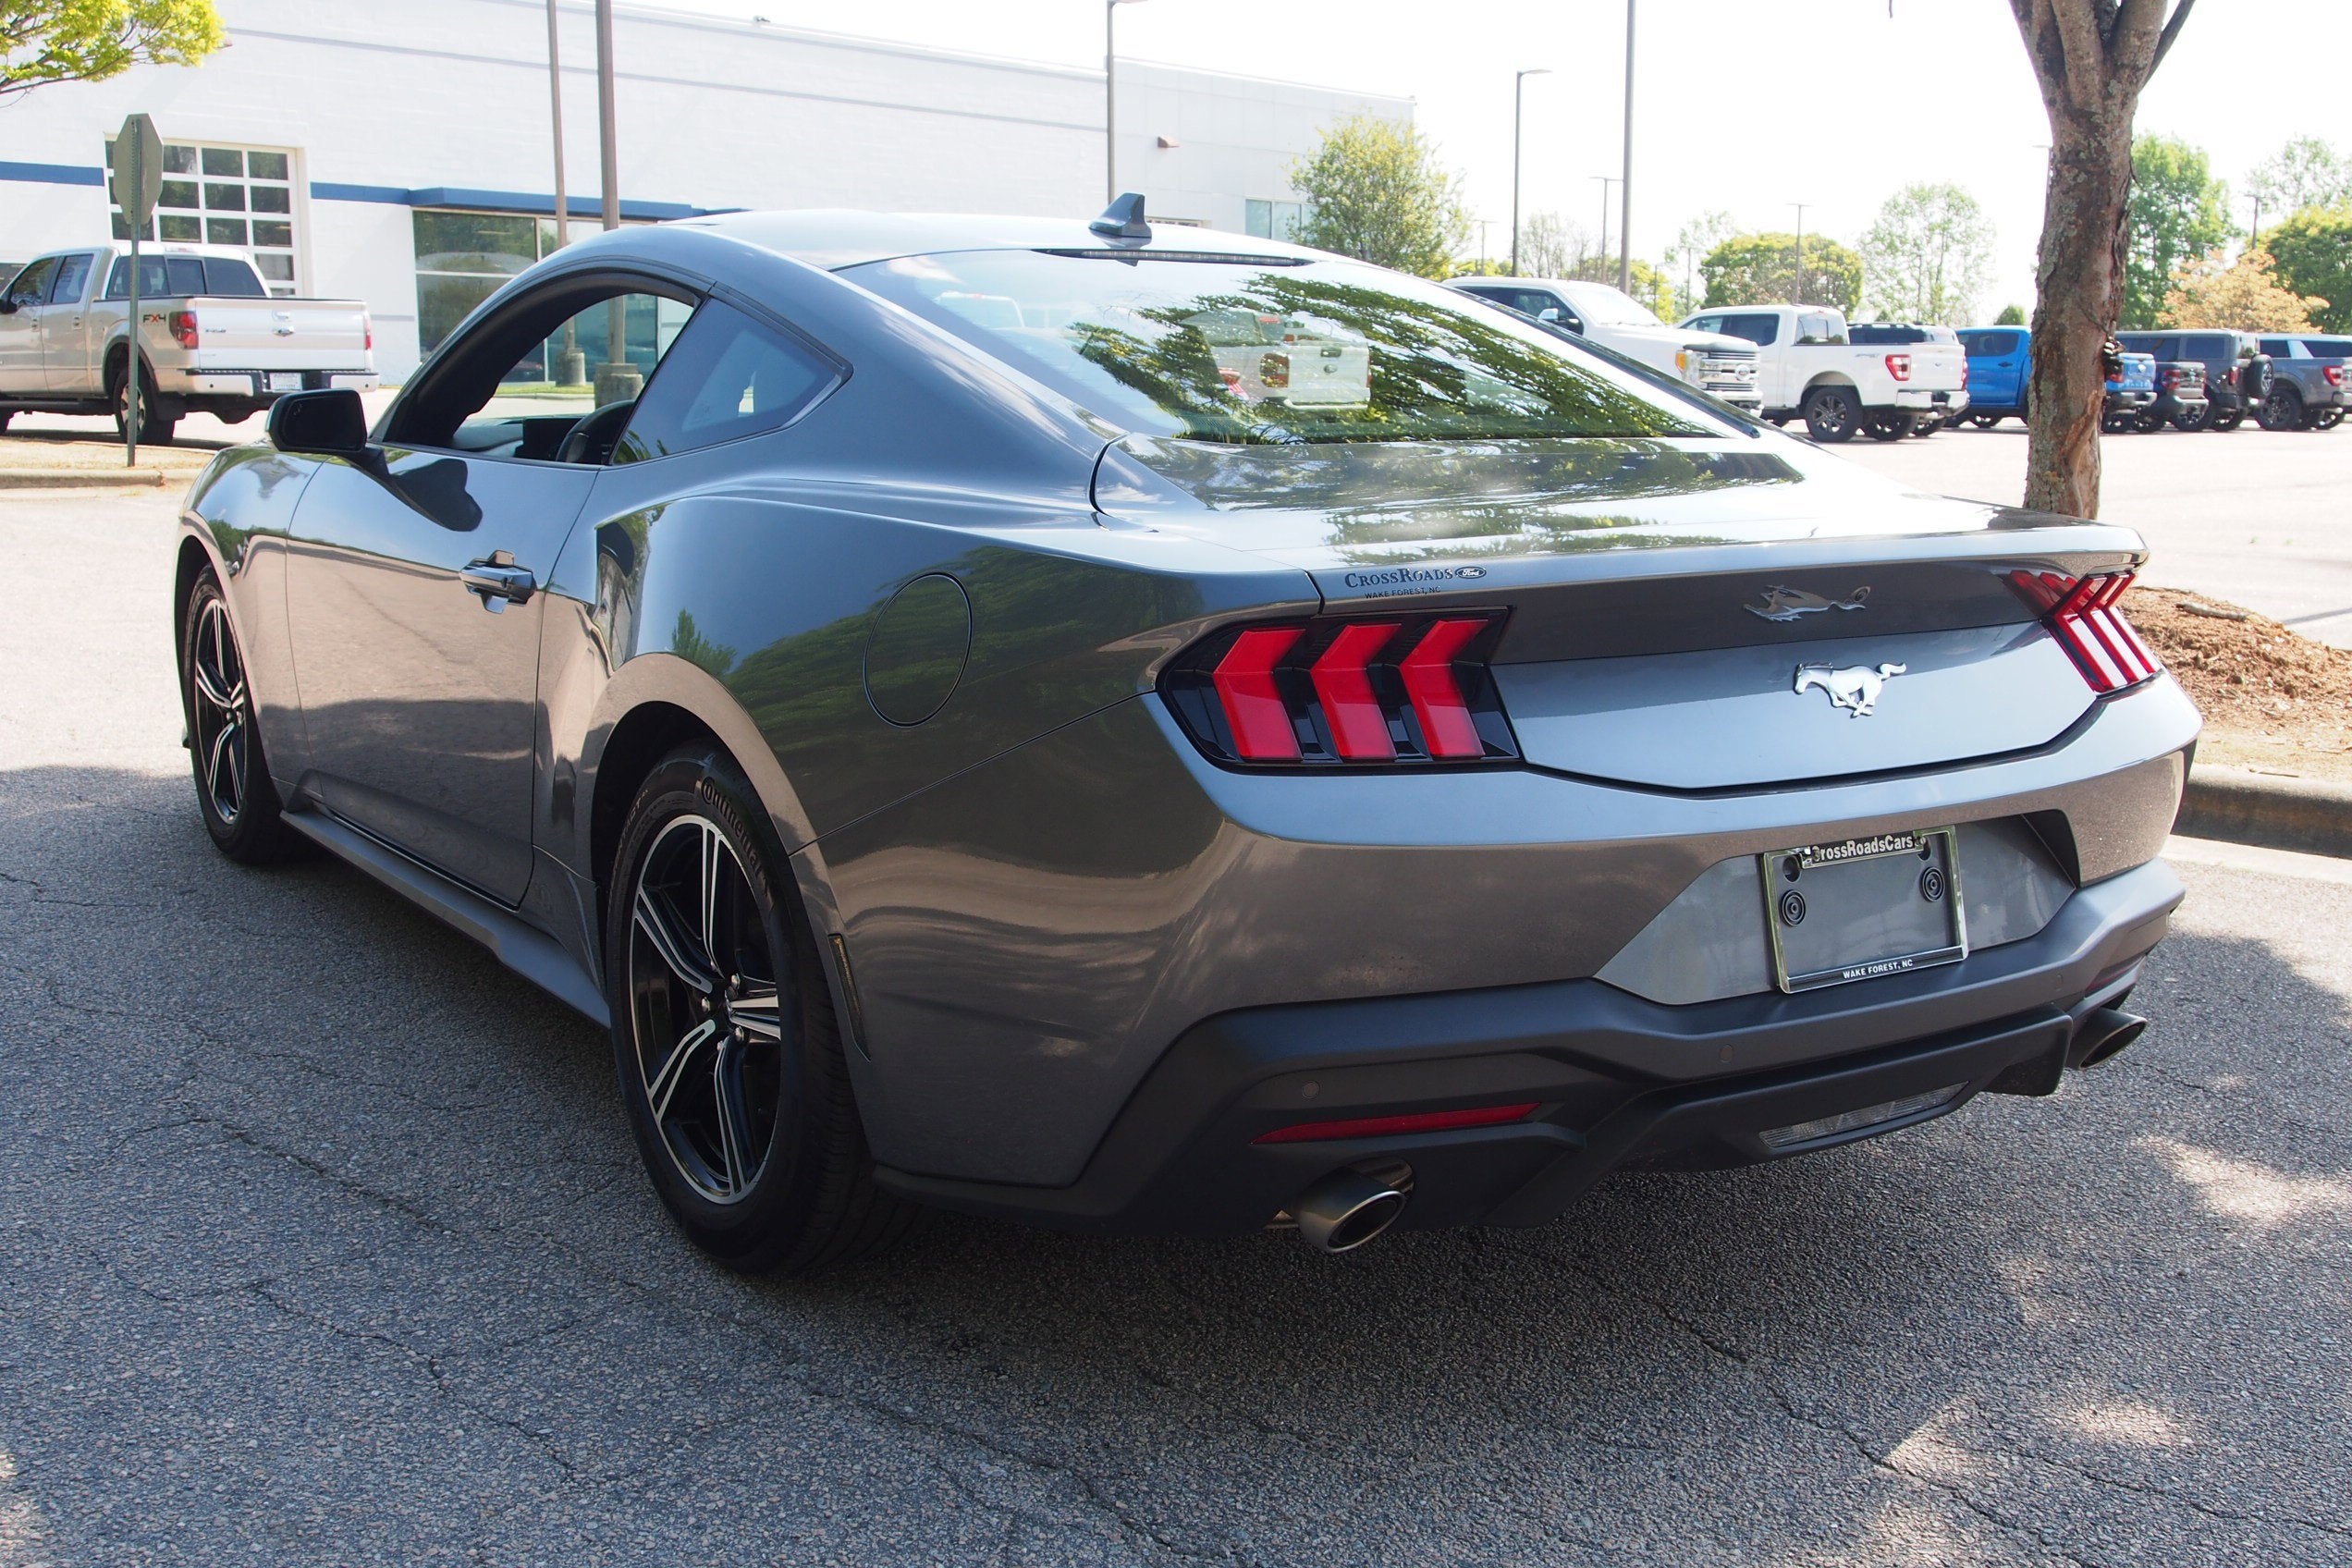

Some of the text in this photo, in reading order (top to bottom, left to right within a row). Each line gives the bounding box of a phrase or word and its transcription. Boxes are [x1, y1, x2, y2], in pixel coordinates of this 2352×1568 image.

[142, 313, 166, 324] FX4
[1365, 585, 1441, 599] WAKE FOREST, NC
[1843, 959, 1914, 979] WAKE FOREST, NC
